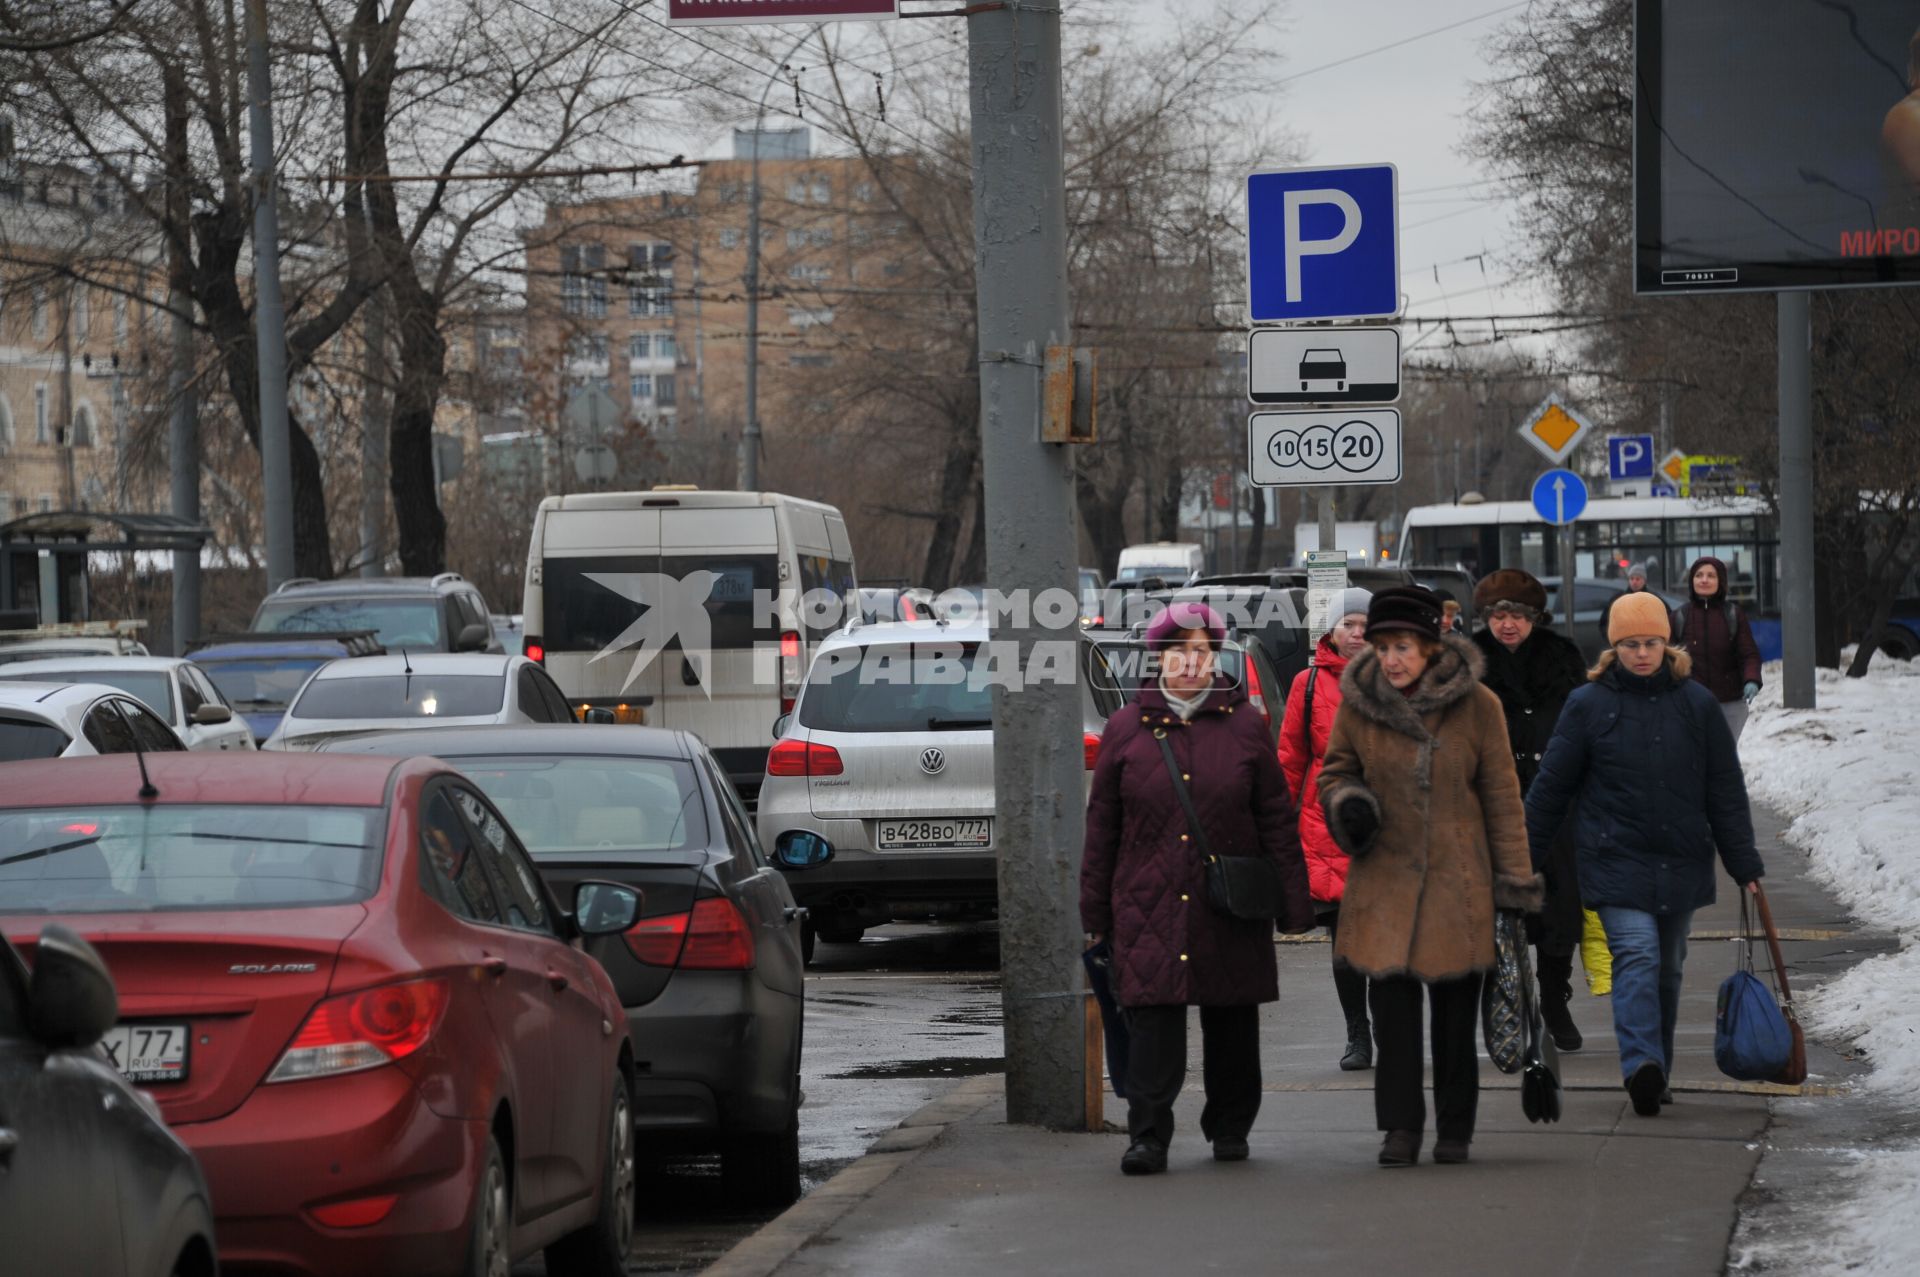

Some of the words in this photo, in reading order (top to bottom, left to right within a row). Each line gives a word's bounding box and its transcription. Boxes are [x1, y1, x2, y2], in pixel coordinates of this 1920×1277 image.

[1283, 188, 1362, 303] P
[1273, 440, 1295, 456] 10
[1303, 438, 1329, 457] 15
[1341, 435, 1374, 458] 20
[1619, 440, 1644, 476] P
[957, 821, 983, 834] 777
[228, 963, 317, 974] SOLARIS
[136, 1030, 173, 1057] 77
[132, 1059, 160, 1068] RUS
